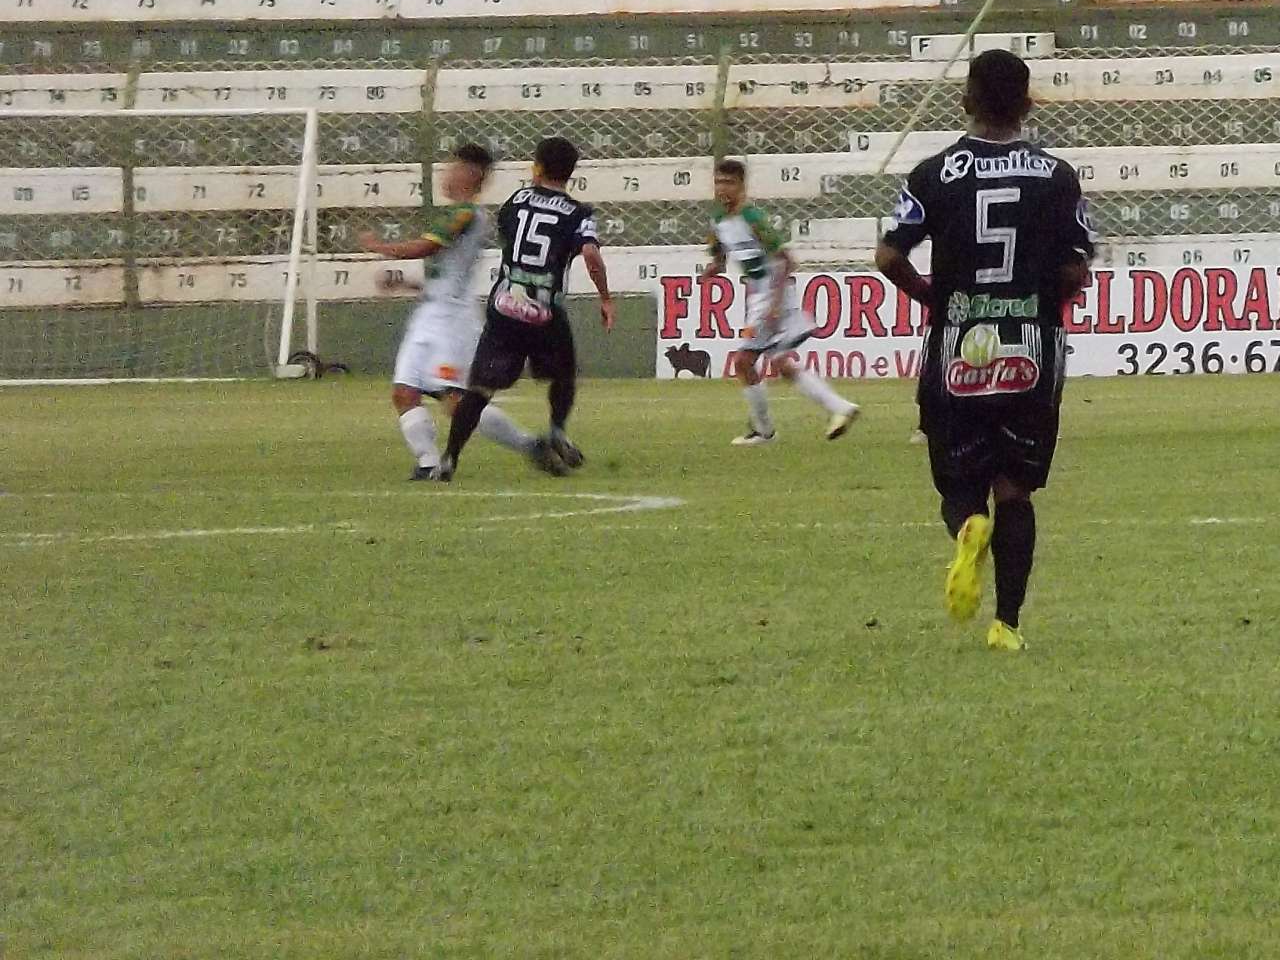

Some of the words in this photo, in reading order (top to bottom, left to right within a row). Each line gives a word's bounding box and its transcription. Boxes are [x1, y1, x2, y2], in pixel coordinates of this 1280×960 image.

[918, 37, 932, 54] F
[1025, 35, 1037, 53] F
[512, 208, 559, 267] 15
[975, 187, 1021, 284] 5
